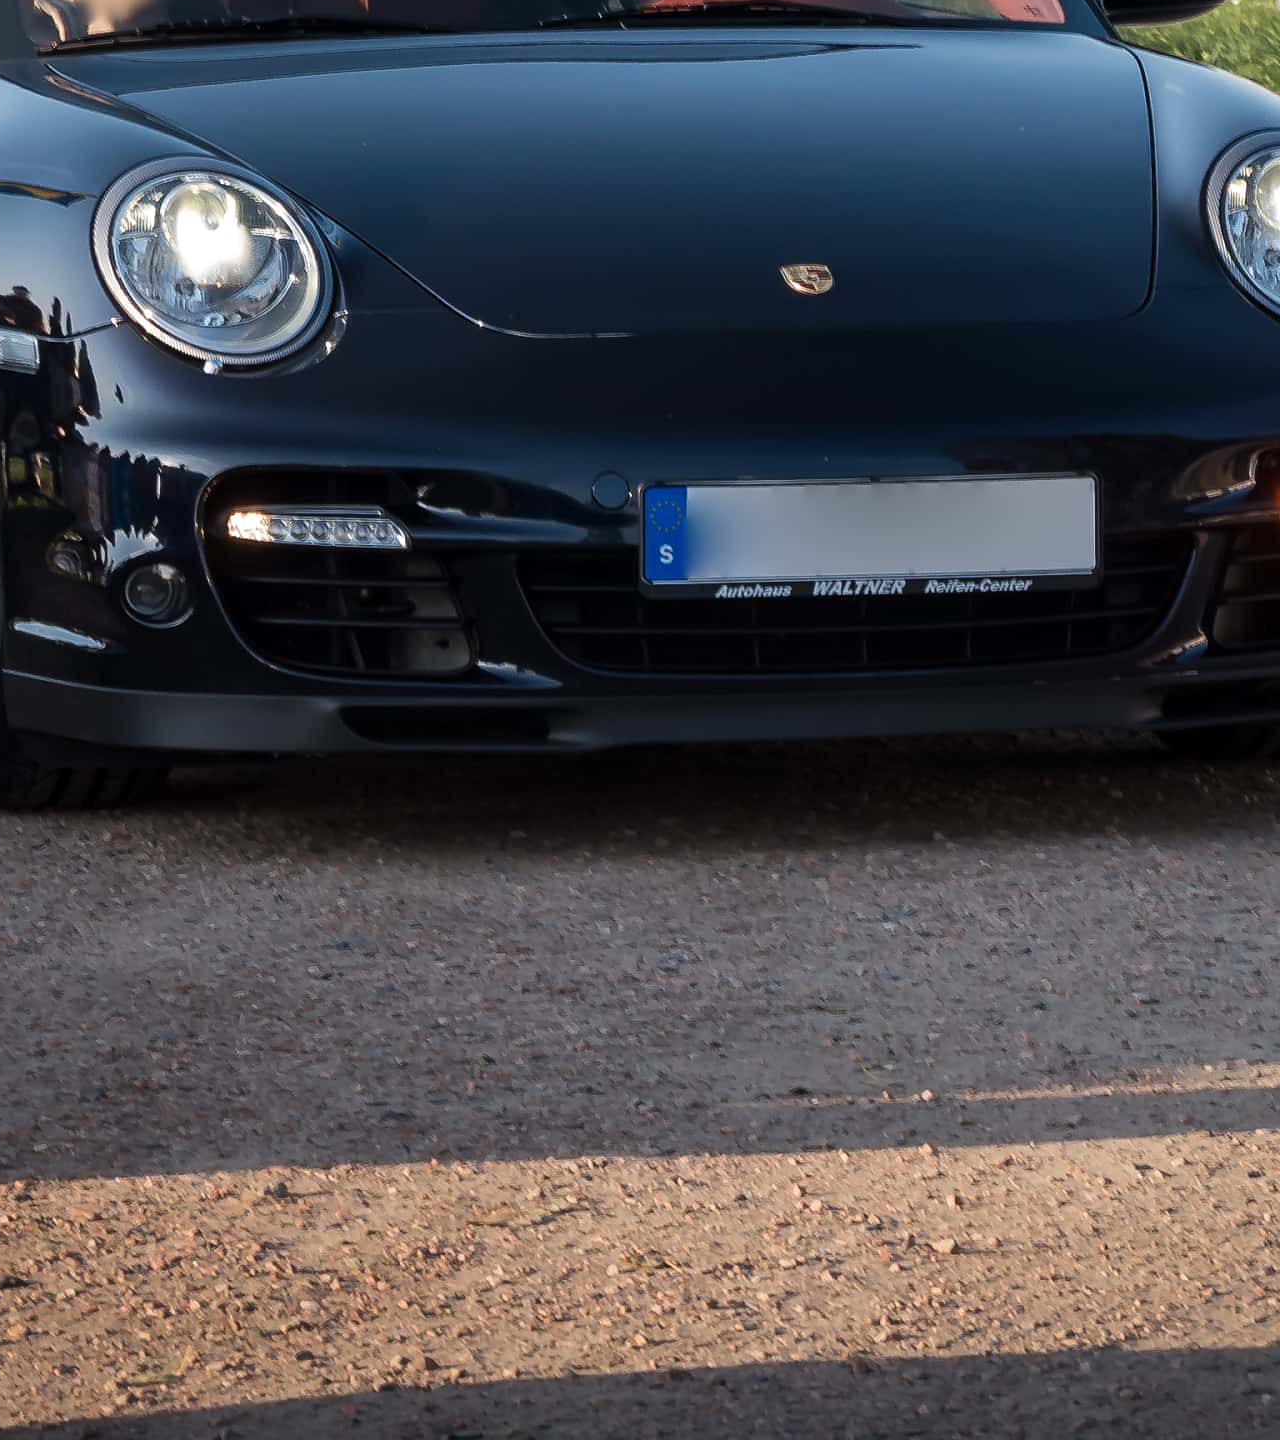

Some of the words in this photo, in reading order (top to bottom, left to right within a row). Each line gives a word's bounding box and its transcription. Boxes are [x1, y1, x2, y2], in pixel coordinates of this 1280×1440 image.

[658, 544, 674, 565] S
[714, 583, 793, 599] Autohaus
[812, 578, 907, 597] WALTNER
[924, 577, 1034, 595] Reifen-Center
